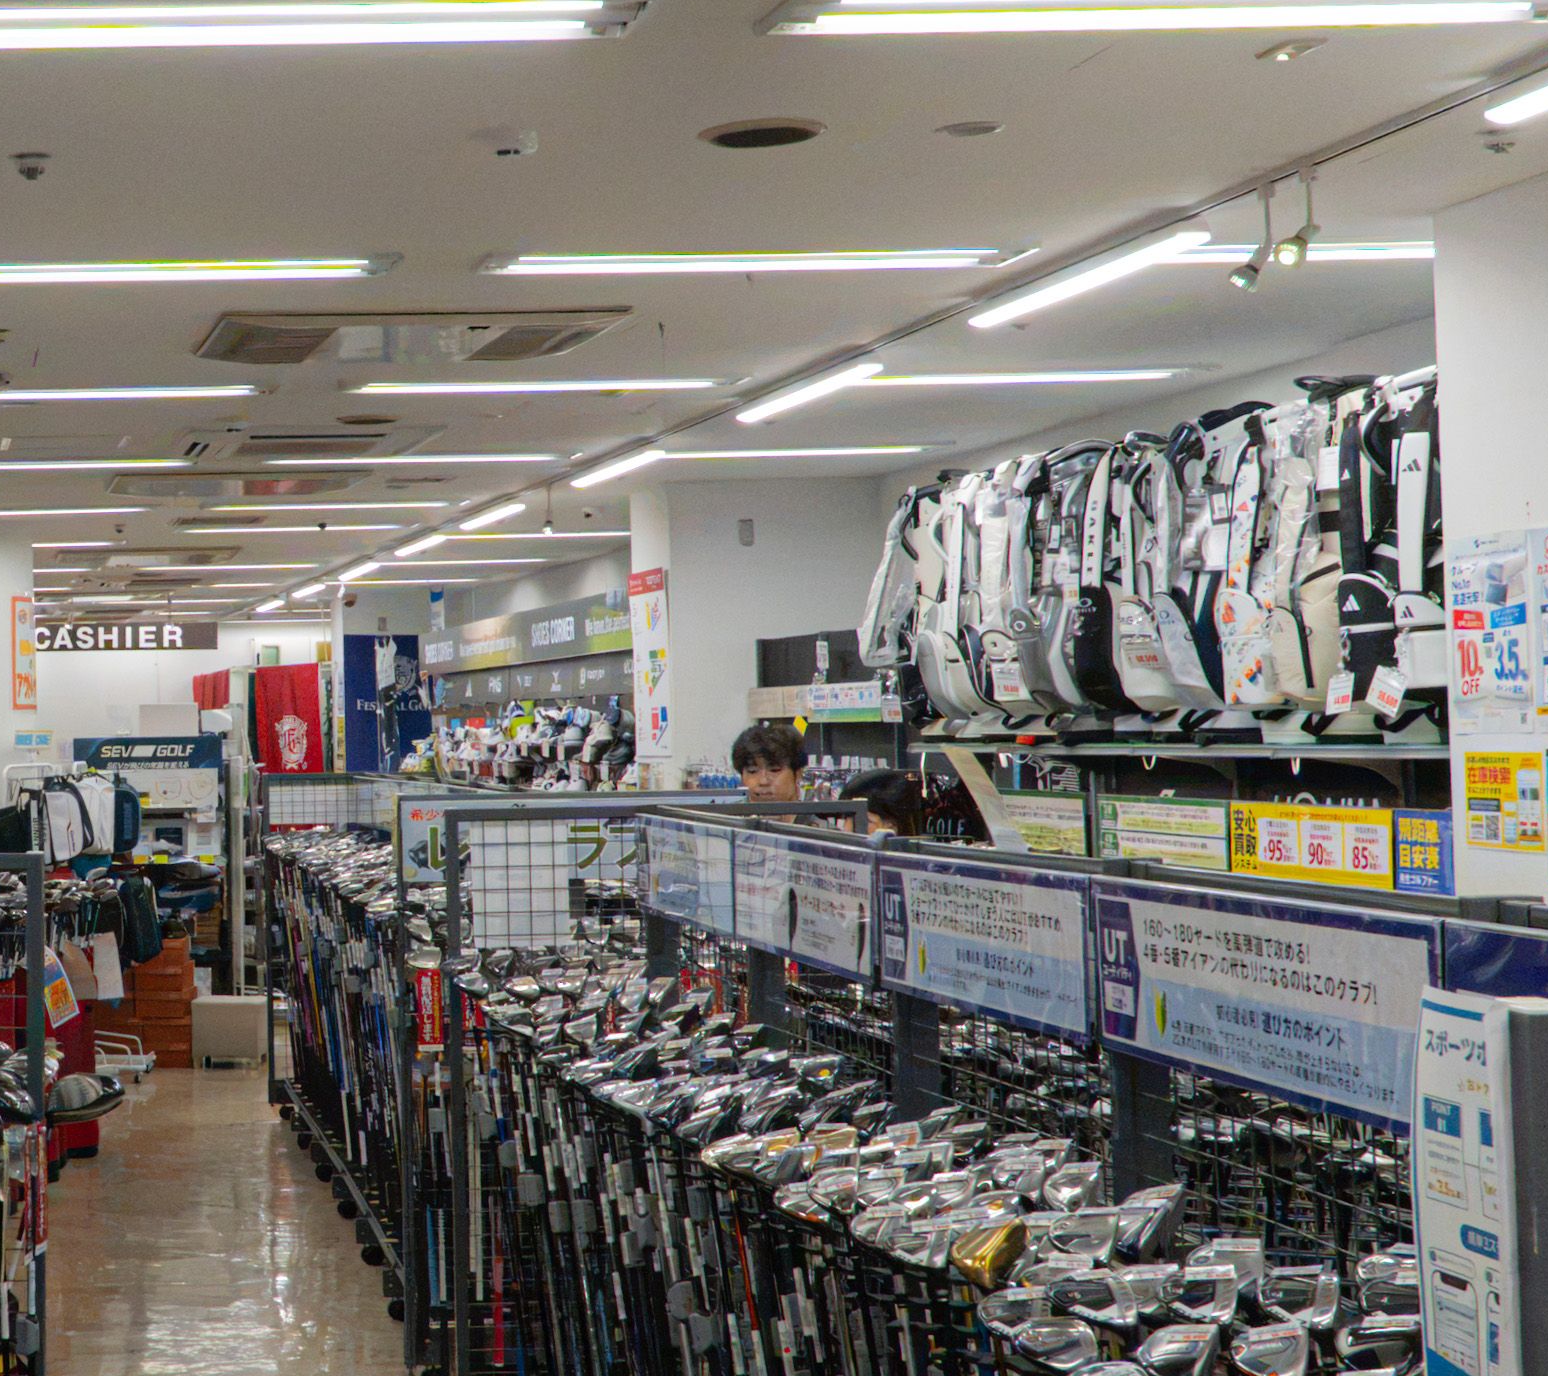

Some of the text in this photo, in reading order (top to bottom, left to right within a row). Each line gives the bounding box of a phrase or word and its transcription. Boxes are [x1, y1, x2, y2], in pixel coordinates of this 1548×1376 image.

[35, 626, 184, 649] CASHIER
[1461, 678, 1481, 696] OFF
[100, 744, 196, 758] SEV GOLF
[1232, 809, 1257, 834] 安心
[1232, 834, 1258, 857] 買取
[1398, 844, 1441, 871] 目安表
[884, 892, 902, 921] UT
[1103, 927, 1129, 965] UT
